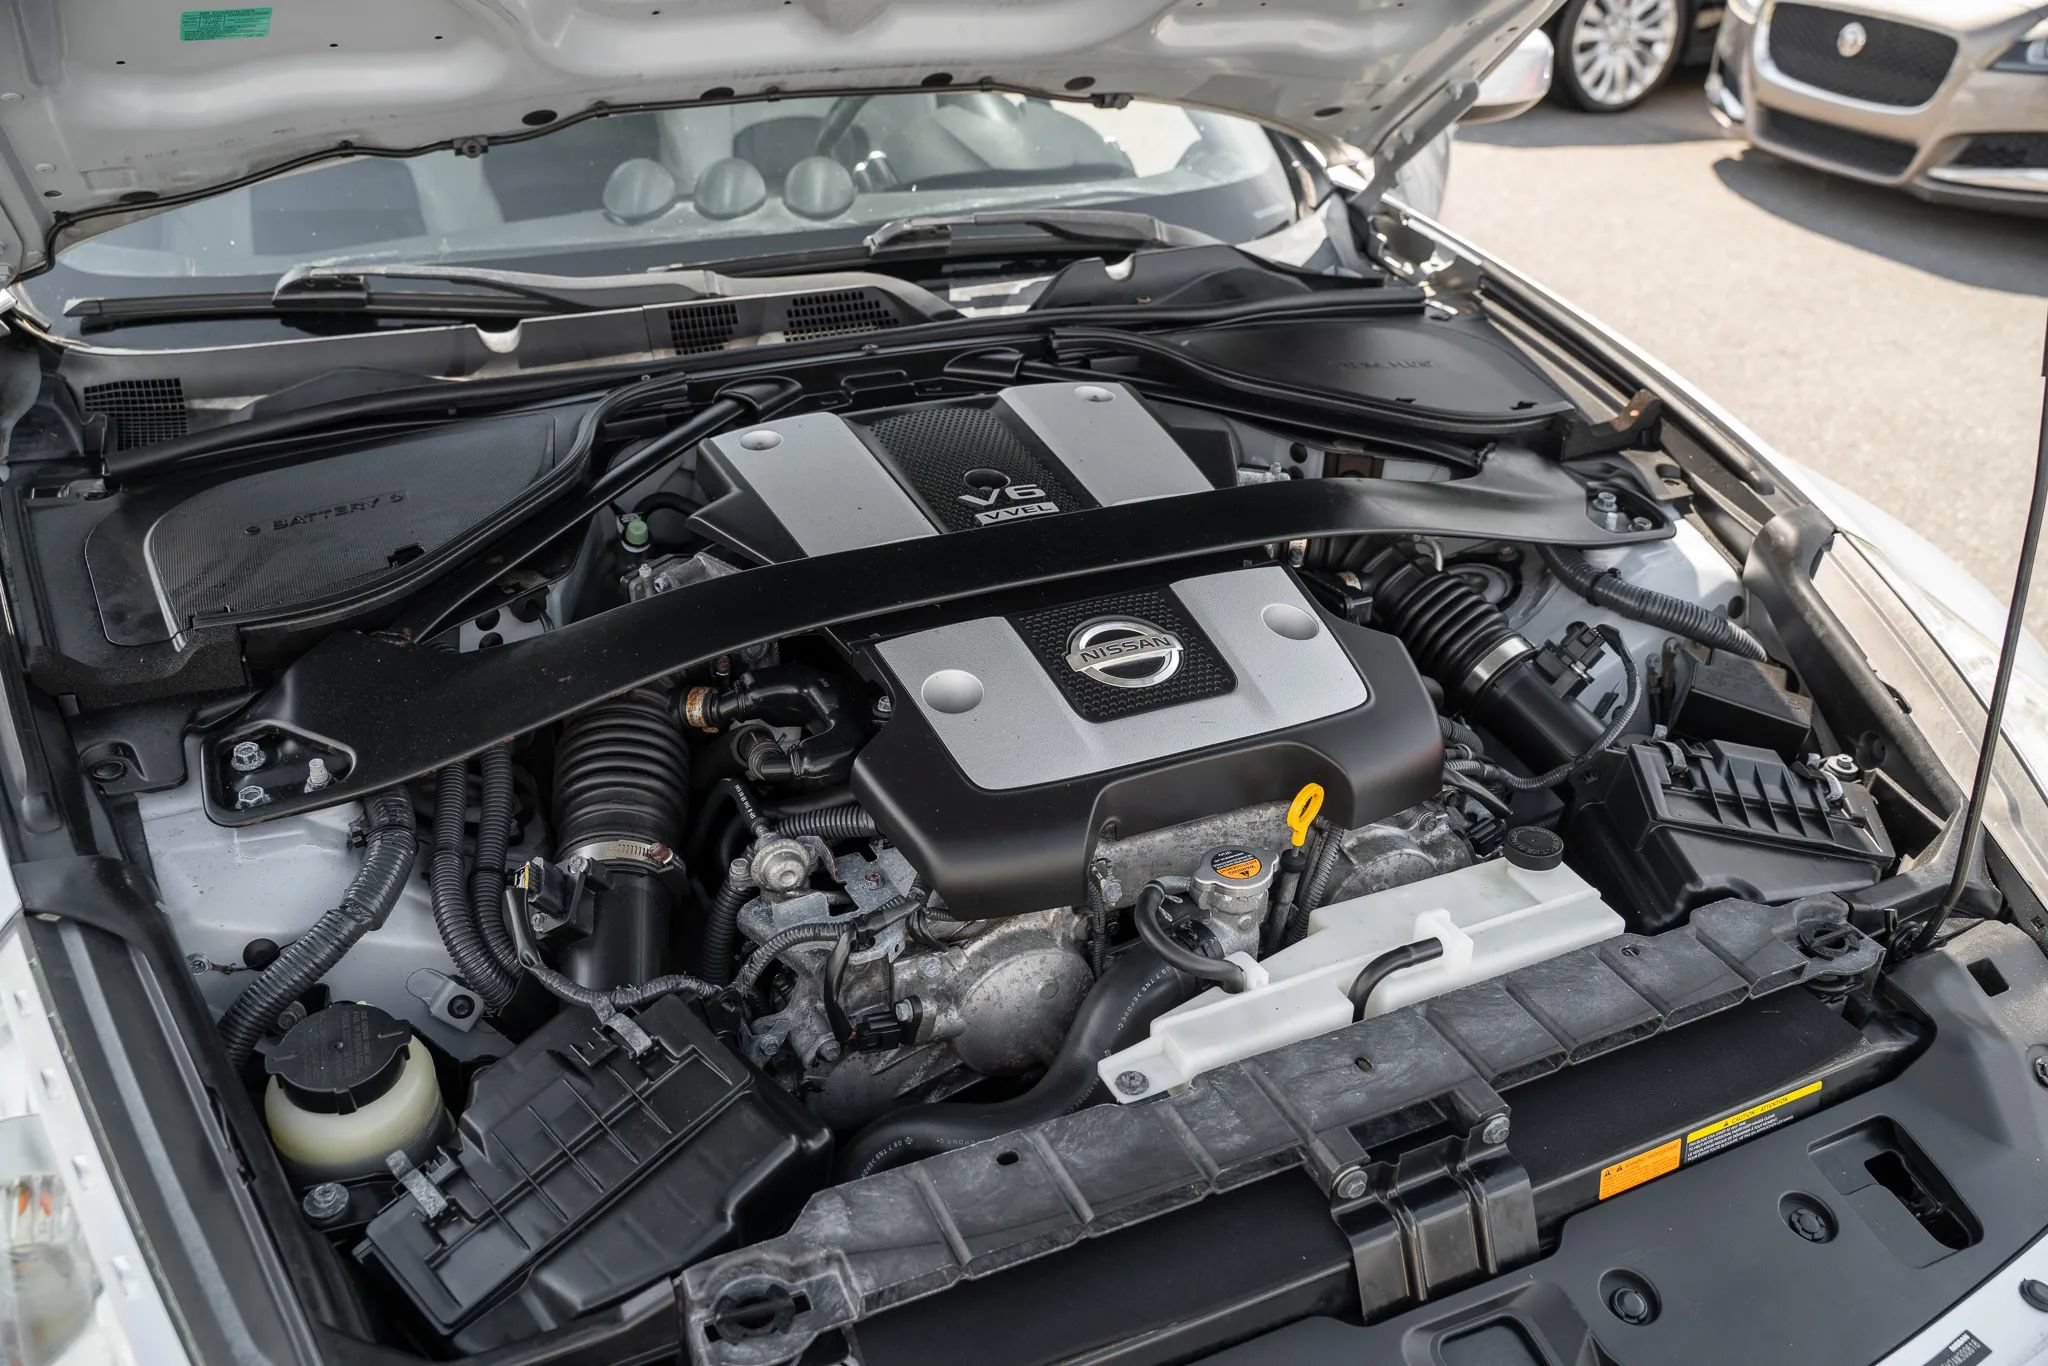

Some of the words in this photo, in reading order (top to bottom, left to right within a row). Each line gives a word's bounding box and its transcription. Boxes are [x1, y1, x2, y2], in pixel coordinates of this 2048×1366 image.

[959, 484, 1046, 506] V6
[272, 498, 380, 531] BATTERY
[983, 504, 1052, 520] VVEL
[1080, 636, 1172, 663] NISSAN
[1732, 1110, 1755, 1122] CAUTION
[1760, 1097, 1788, 1111] ATTENTION
